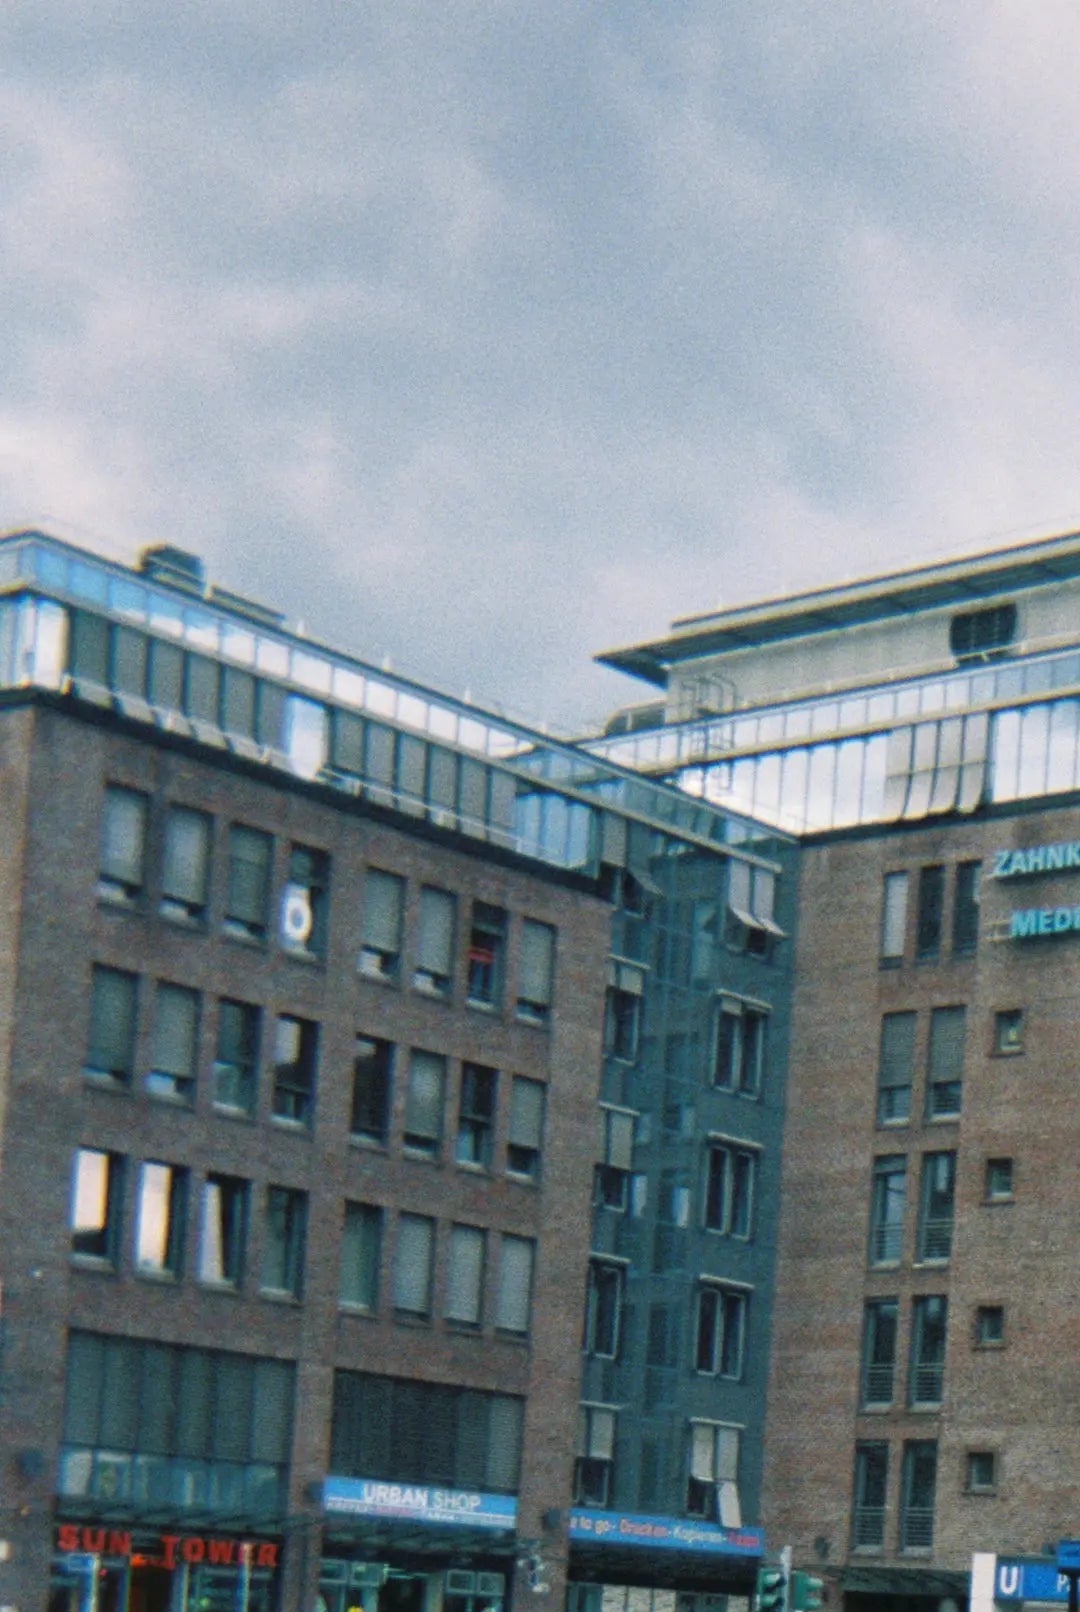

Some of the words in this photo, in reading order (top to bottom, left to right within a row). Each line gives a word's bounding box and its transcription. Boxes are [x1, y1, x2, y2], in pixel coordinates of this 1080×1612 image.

[362, 1482, 428, 1509] URBAN
[433, 1491, 481, 1512] SHOP
[57, 1524, 132, 1555] SUN
[160, 1534, 280, 1570] TOWER
[1000, 1566, 1019, 1594] U
